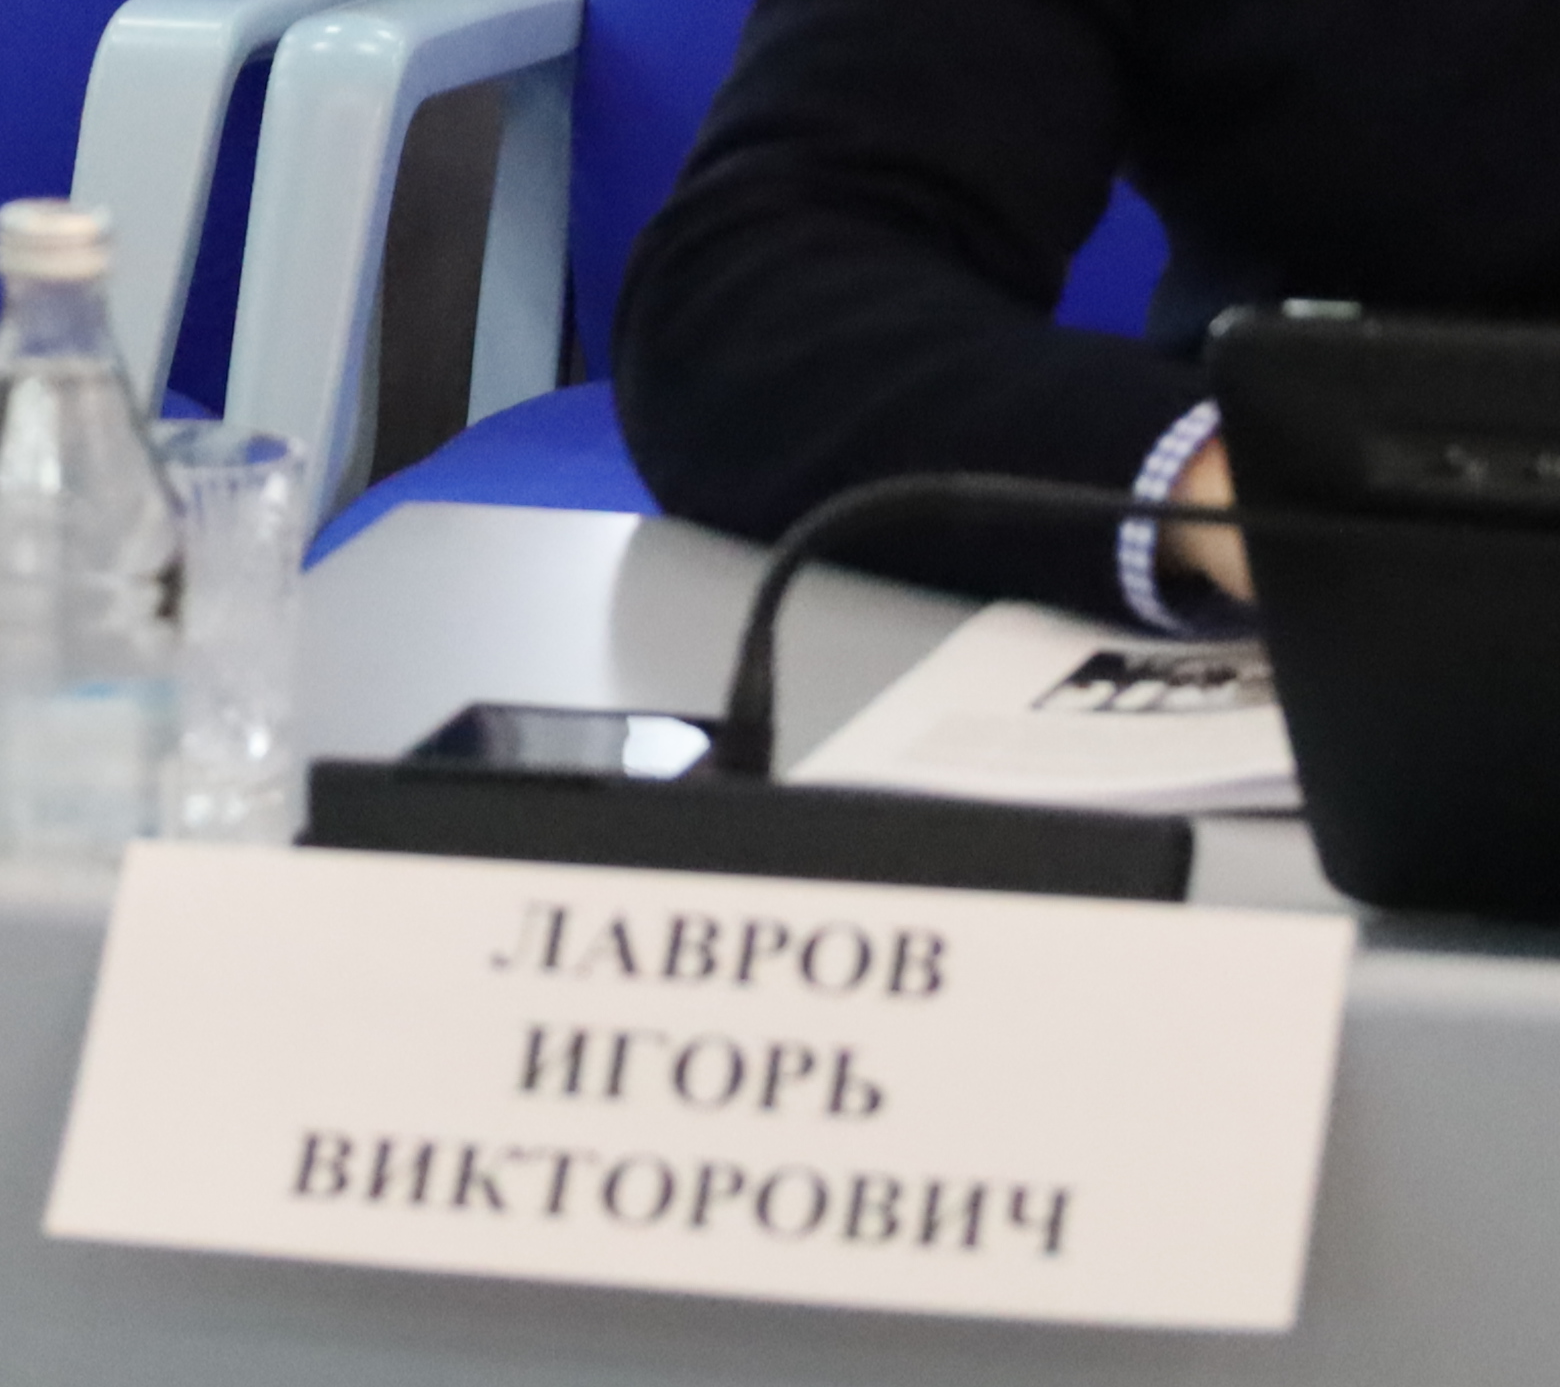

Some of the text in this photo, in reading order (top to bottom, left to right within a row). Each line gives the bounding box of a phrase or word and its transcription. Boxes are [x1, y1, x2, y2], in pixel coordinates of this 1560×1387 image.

[489, 904, 948, 997] ЛАВРОВ
[516, 1023, 885, 1118] ИГОРЬ
[291, 1131, 1071, 1257] ВИКТОРОВИЧ
